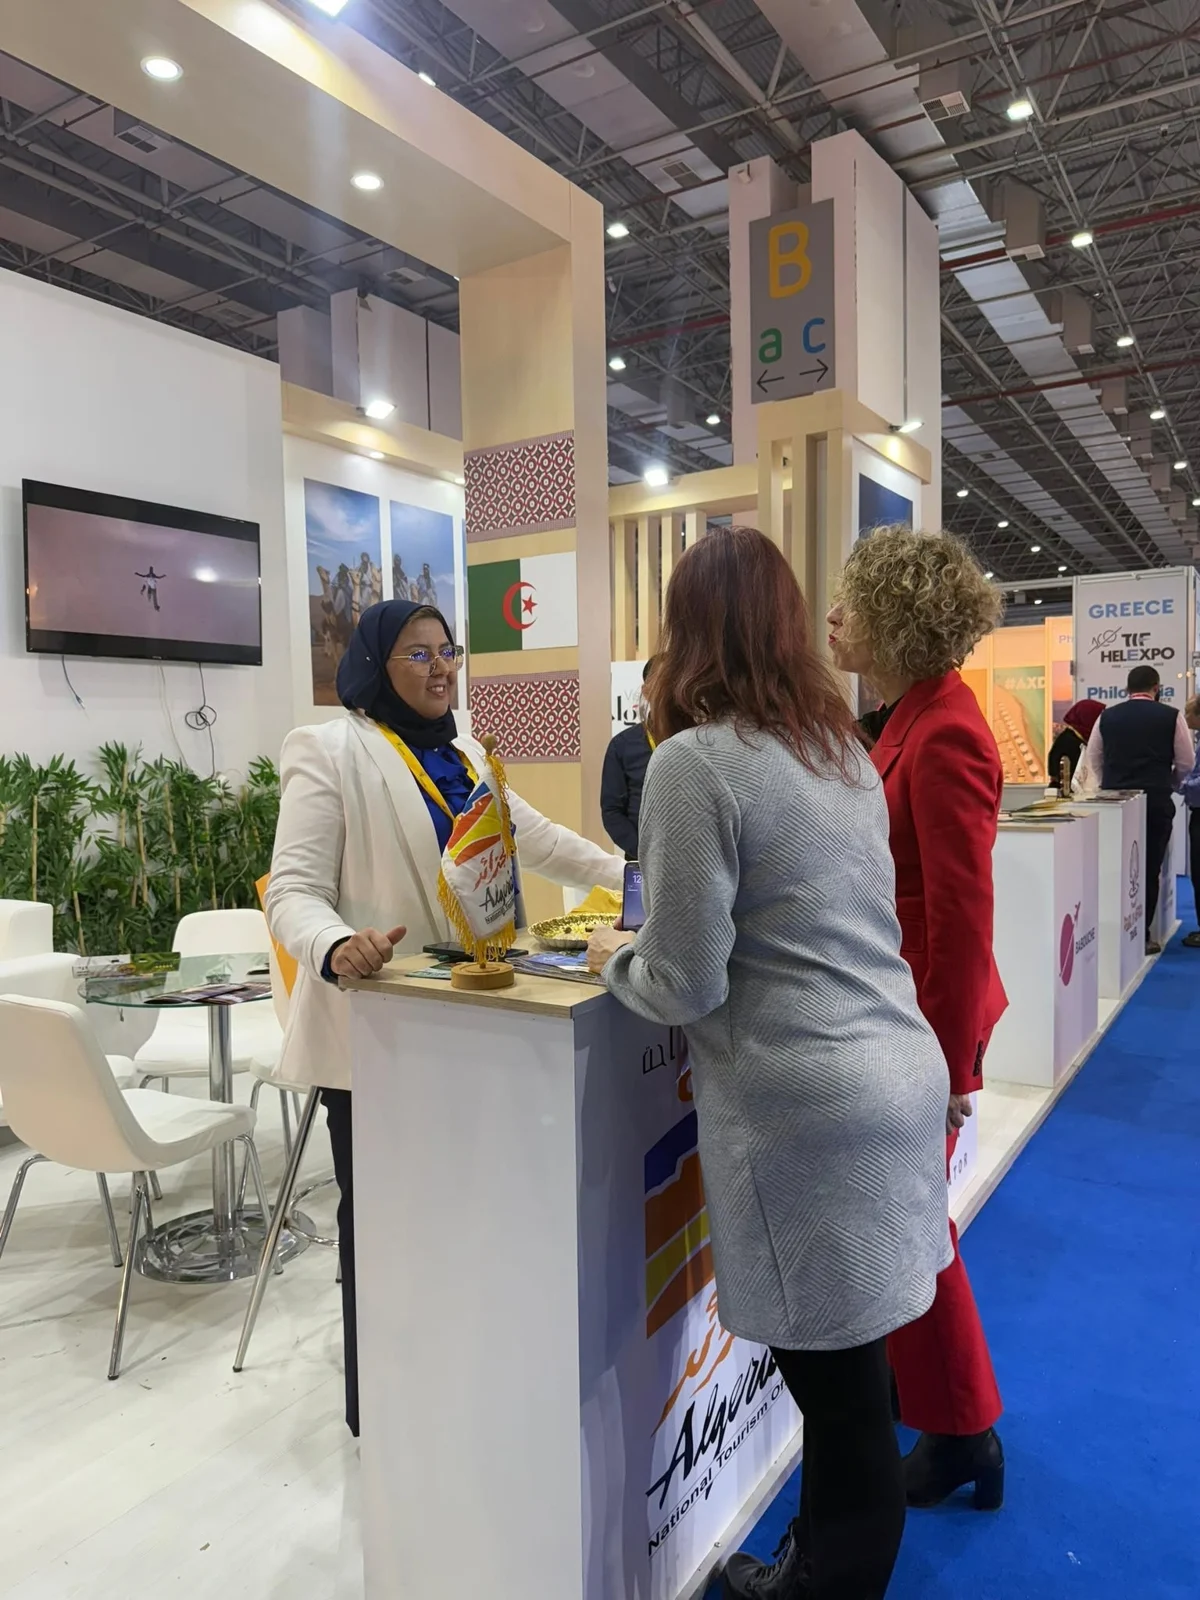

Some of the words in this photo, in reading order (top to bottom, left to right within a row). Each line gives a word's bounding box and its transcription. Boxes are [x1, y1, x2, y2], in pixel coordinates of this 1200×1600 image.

[768, 221, 812, 299] B
[758, 327, 783, 364] a
[1088, 598, 1174, 618] GREECE
[1121, 632, 1151, 647] TIF
[1100, 647, 1175, 663] HELEXPO
[648, 1467, 713, 1557] National
[715, 1402, 768, 1468] Tourism
